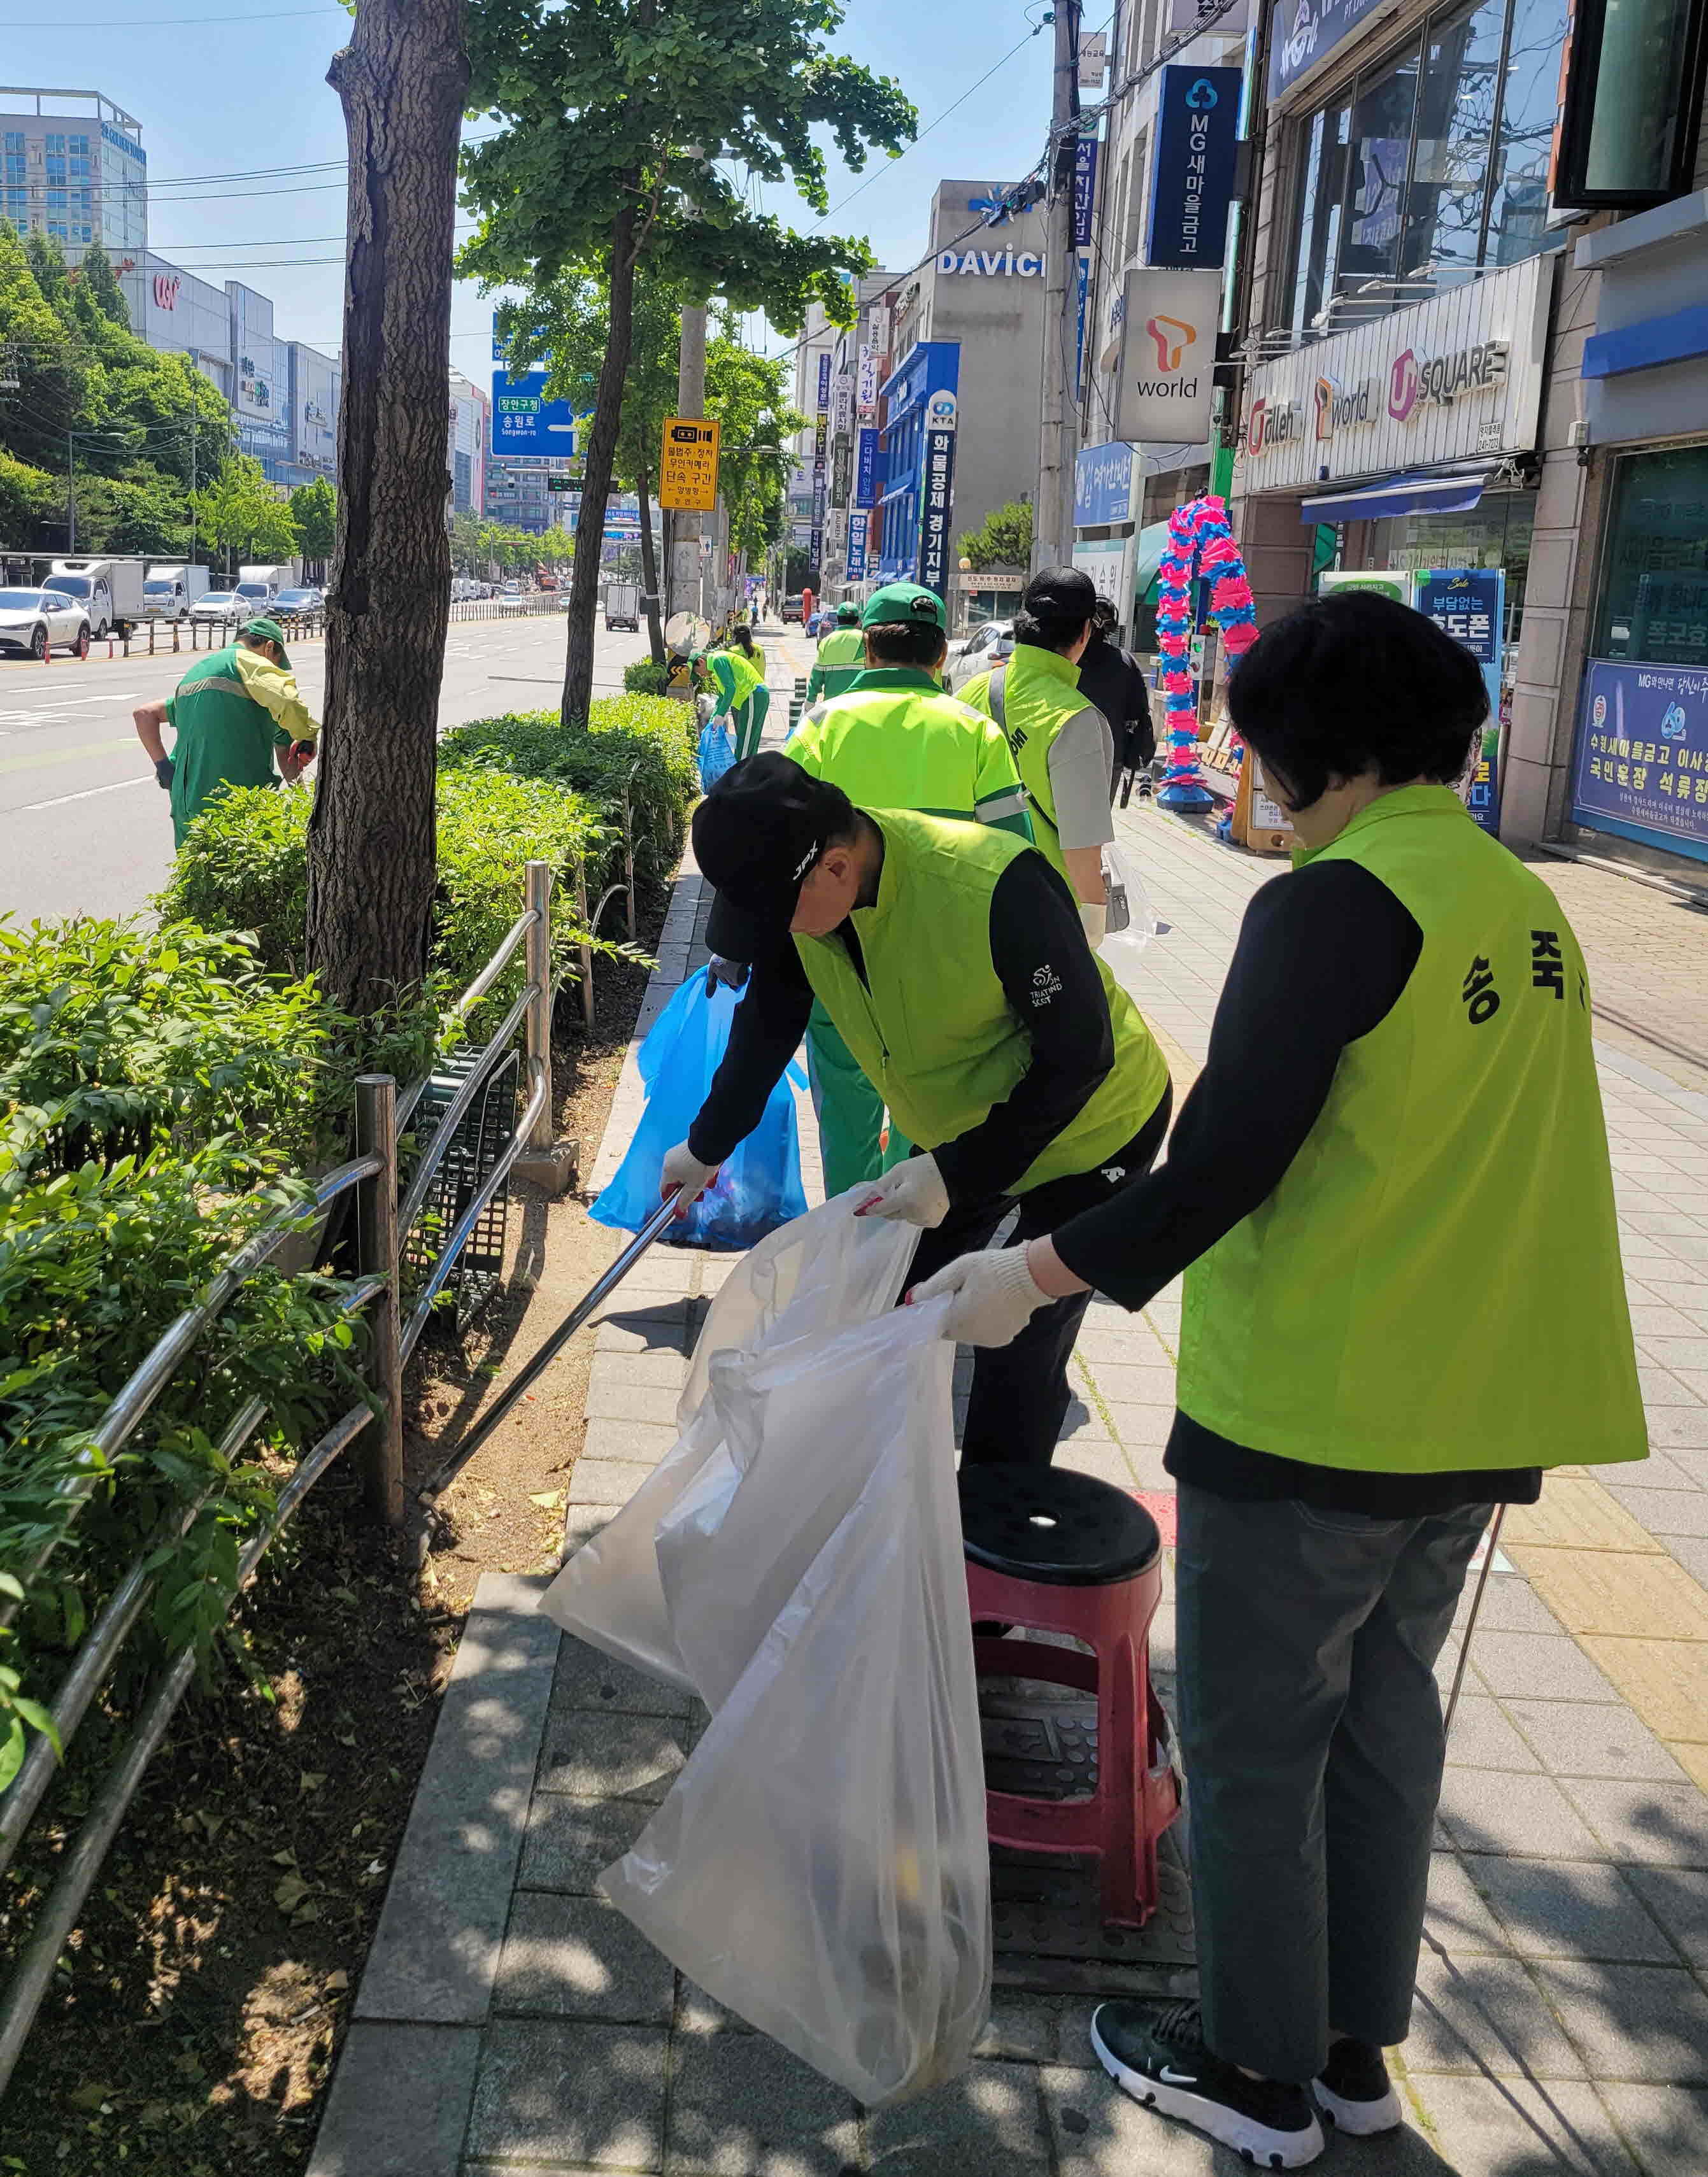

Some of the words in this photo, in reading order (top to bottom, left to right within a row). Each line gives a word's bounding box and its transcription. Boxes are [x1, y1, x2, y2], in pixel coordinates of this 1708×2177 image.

[1179, 115, 1209, 253] MG새마을금고
[1137, 377, 1198, 398] world
[1421, 341, 1497, 404] SQUARE
[501, 399, 537, 411] 장안구청
[502, 415, 536, 428] 송원로
[1332, 385, 1369, 426] world
[666, 471, 686, 483] 단속
[692, 472, 711, 485] 구간
[670, 458, 709, 469] 무인카메라
[929, 434, 950, 509] 화물공제
[925, 514, 944, 587] 경기지부
[1433, 596, 1483, 611] 부담없는
[1447, 577, 1469, 590] Sale
[1591, 734, 1670, 765] 수원새마을금고
[1677, 748, 1708, 774] 이사
[1590, 756, 1648, 790] 국민훈장
[1660, 771, 1708, 804] 석류장
[793, 840, 818, 880] JPX
